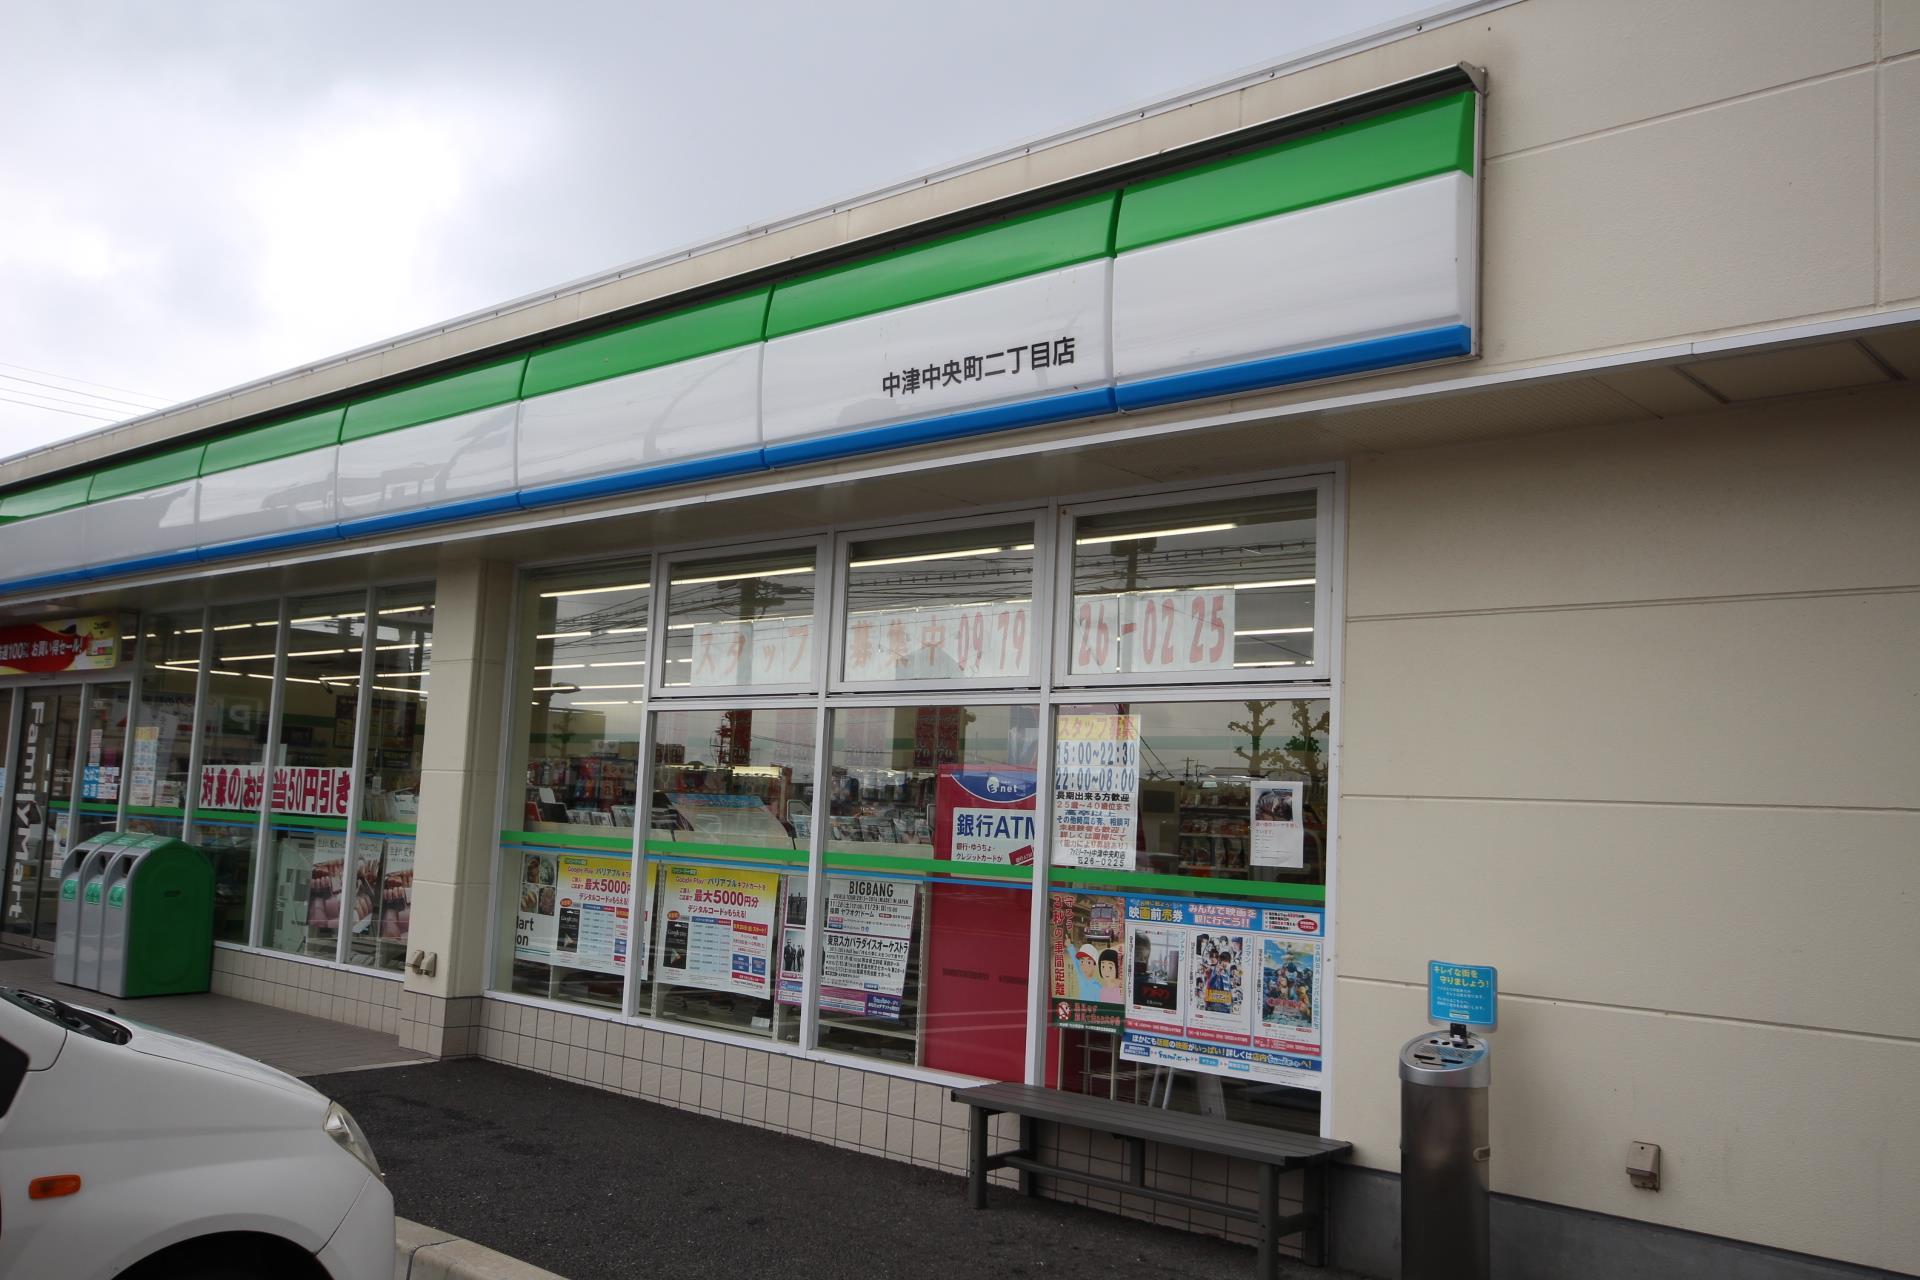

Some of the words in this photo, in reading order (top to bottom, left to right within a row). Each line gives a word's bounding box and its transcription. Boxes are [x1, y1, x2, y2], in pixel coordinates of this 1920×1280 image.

[882, 336, 1075, 398] 中津中央町二丁目店
[695, 624, 809, 676] スタッフ
[957, 608, 1026, 671] 0979
[1078, 595, 1226, 667] 26-0225
[1056, 791, 1130, 802] 長期出来る方歓迎
[8, 701, 46, 919] FamilyMart
[694, 888, 760, 908] 最大5000円分
[848, 881, 894, 898] BIGBANG
[1128, 906, 1183, 922] 映画前売券
[1189, 903, 1257, 919] みんなで映画を
[516, 916, 534, 931] art
[827, 934, 909, 954] 東京スカパラダイスオーケストラ
